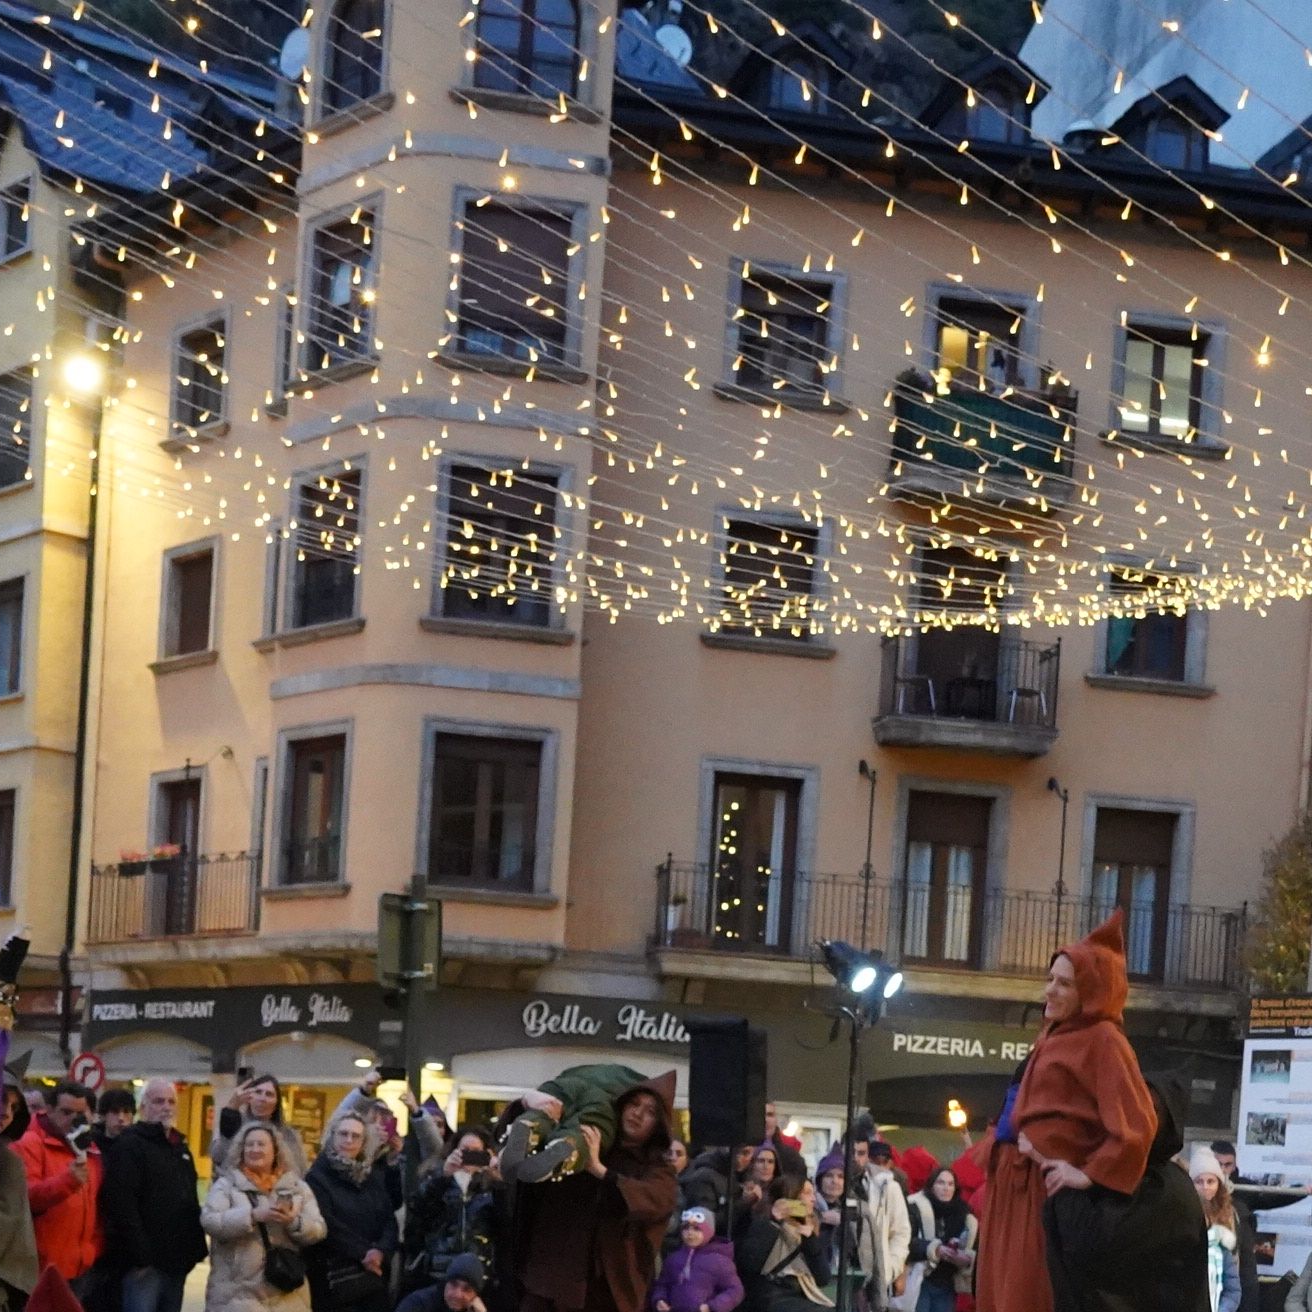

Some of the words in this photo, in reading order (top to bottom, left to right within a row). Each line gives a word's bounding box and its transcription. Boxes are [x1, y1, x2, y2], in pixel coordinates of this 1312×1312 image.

[92, 1002, 137, 1021] PIZZERIA
[143, 1000, 215, 1019] RESTAURANT
[261, 993, 302, 1027] Bella
[522, 1000, 603, 1037] Bella
[893, 1033, 984, 1058] PIZZERIA
